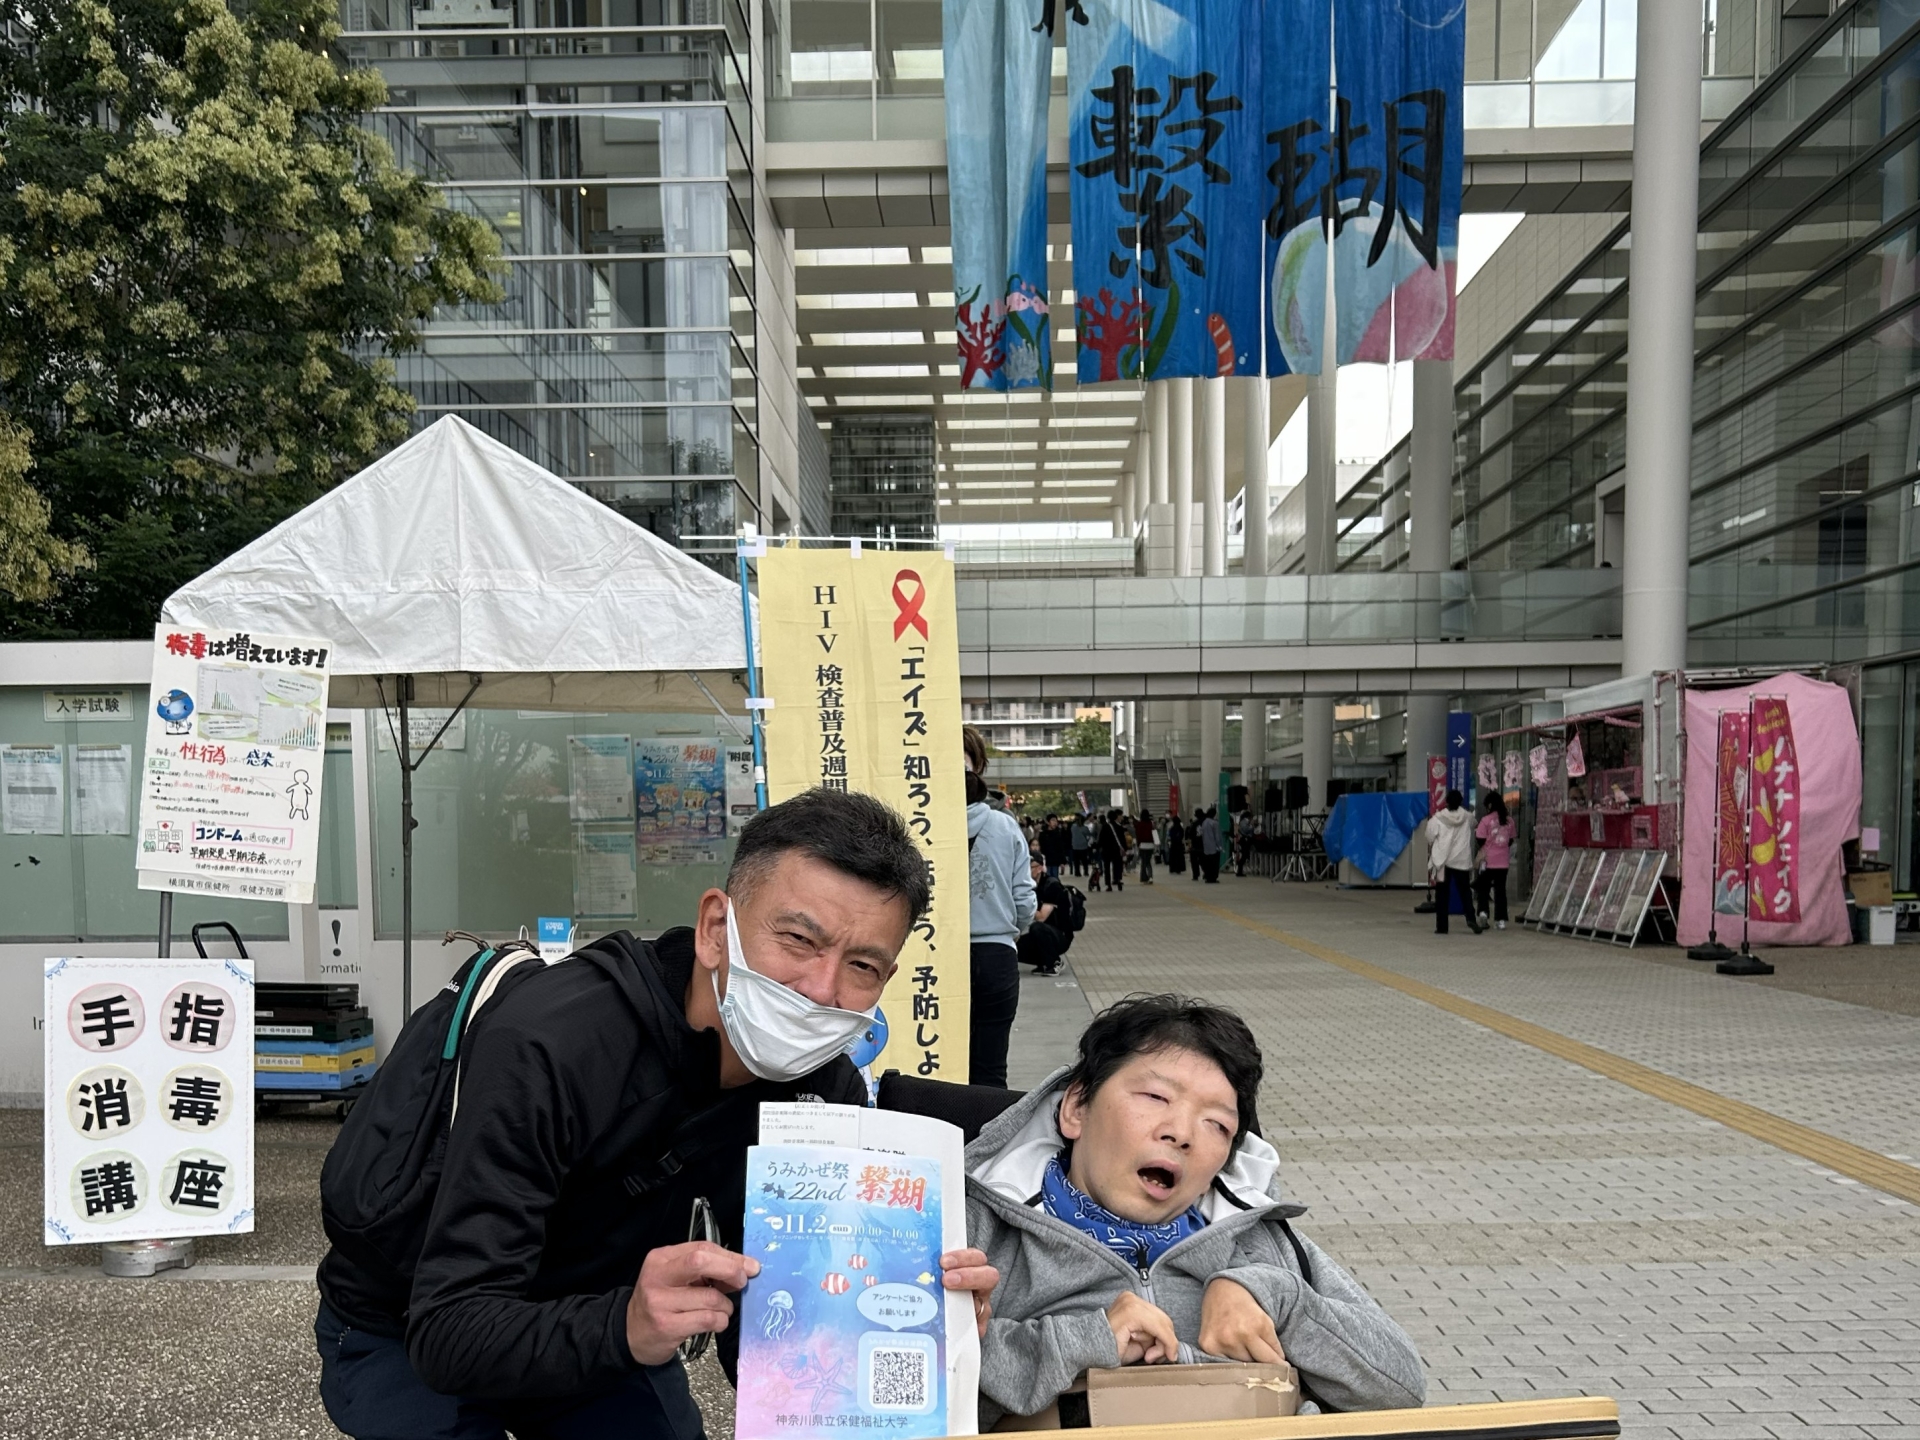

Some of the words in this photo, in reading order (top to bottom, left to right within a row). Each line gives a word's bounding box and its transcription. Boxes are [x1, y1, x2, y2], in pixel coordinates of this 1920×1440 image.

[56, 697, 120, 713] 入学試験
[168, 877, 231, 892] 横須賀市保健所
[239, 884, 284, 897] 保健予防課
[320, 962, 361, 975] ormati
[767, 1161, 850, 1180] うみかぜ祭
[788, 1182, 848, 1201] 22nd
[784, 1214, 828, 1234] 11.2
[872, 1293, 923, 1304] アンケートご協力
[878, 1308, 917, 1318] お願いします
[775, 1414, 908, 1429] 神奈川県立保健福祉大学
